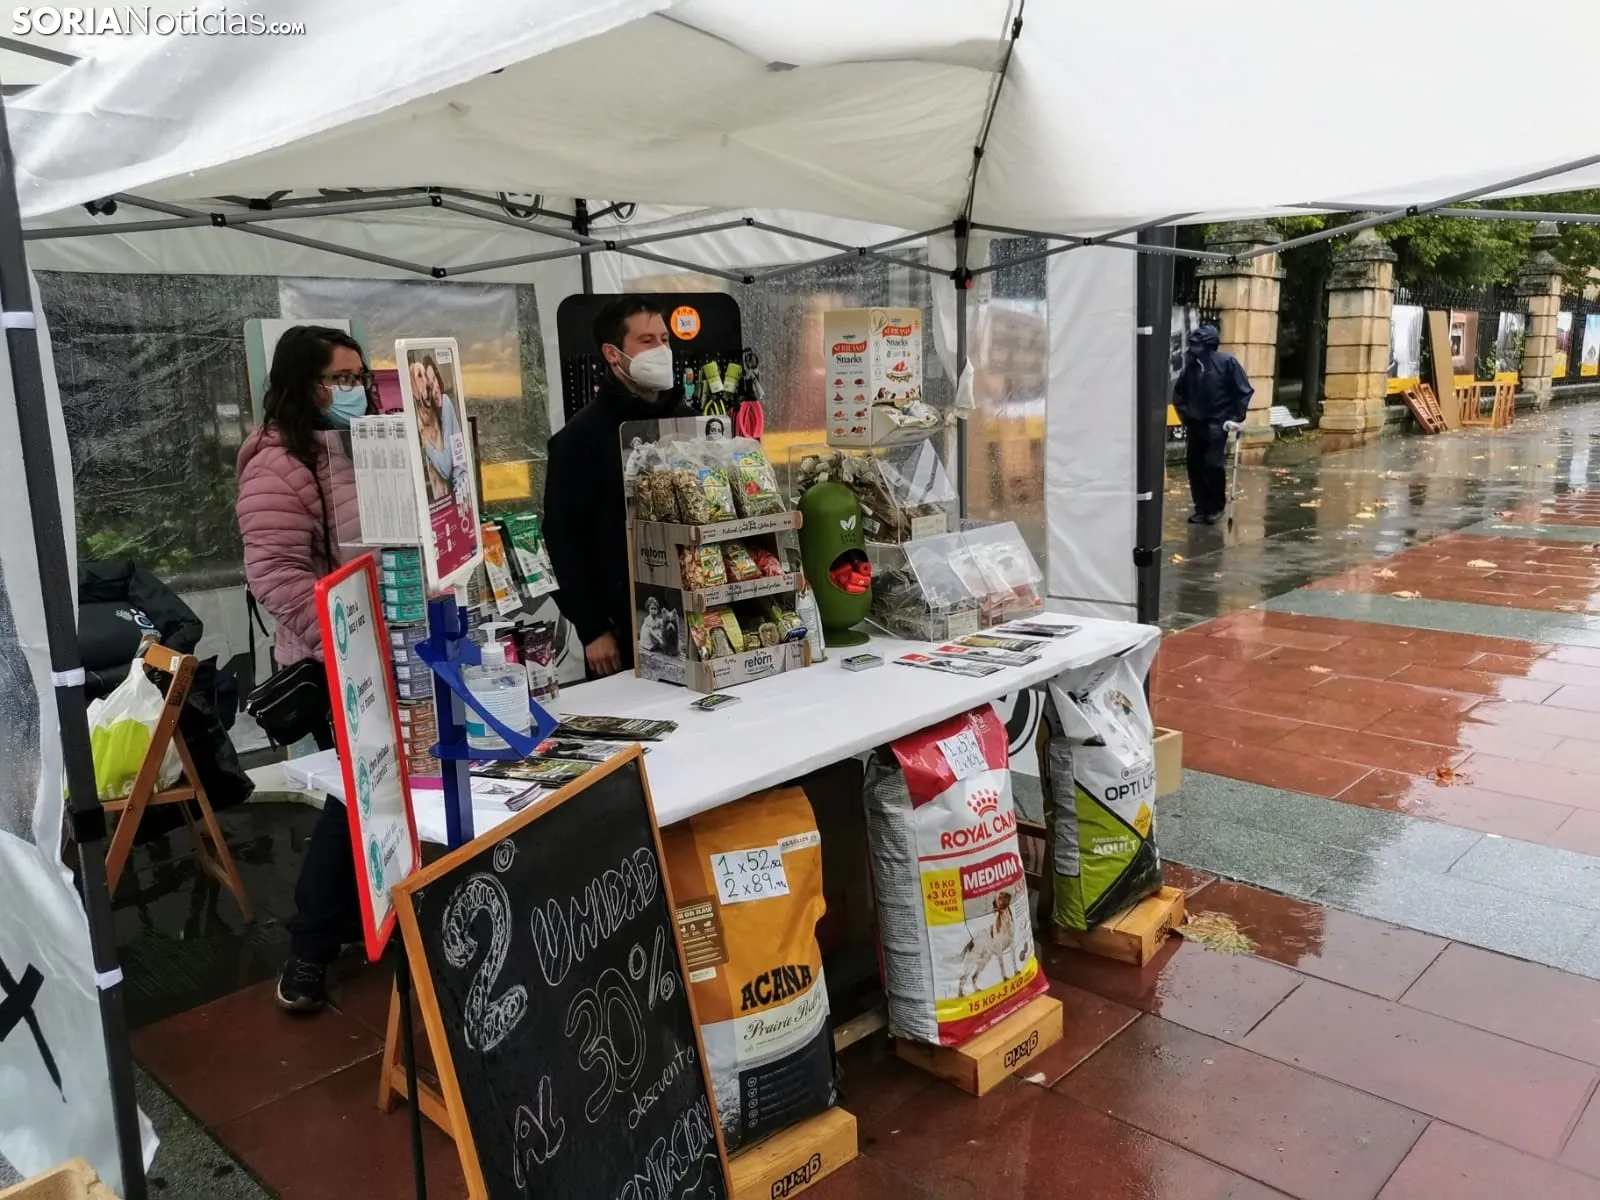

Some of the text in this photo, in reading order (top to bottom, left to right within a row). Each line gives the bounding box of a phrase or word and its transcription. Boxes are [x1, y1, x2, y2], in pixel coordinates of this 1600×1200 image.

[836, 353, 863, 364] Snacks
[743, 653, 773, 669] retorn
[1105, 779, 1141, 801] OPTI
[940, 820, 992, 850] ROYAL
[1093, 839, 1138, 855] ADULT
[717, 854, 735, 876] 1
[963, 856, 1018, 891] MEDIUM
[724, 878, 740, 898] 2
[927, 888, 957, 900] +3 KG
[942, 879, 956, 889] KG
[741, 964, 813, 1012] ACANA
[968, 1000, 980, 1013] 15
[1010, 976, 1024, 993] KG
[743, 1016, 793, 1041] Prairie
[628, 1044, 696, 1129] descuento
